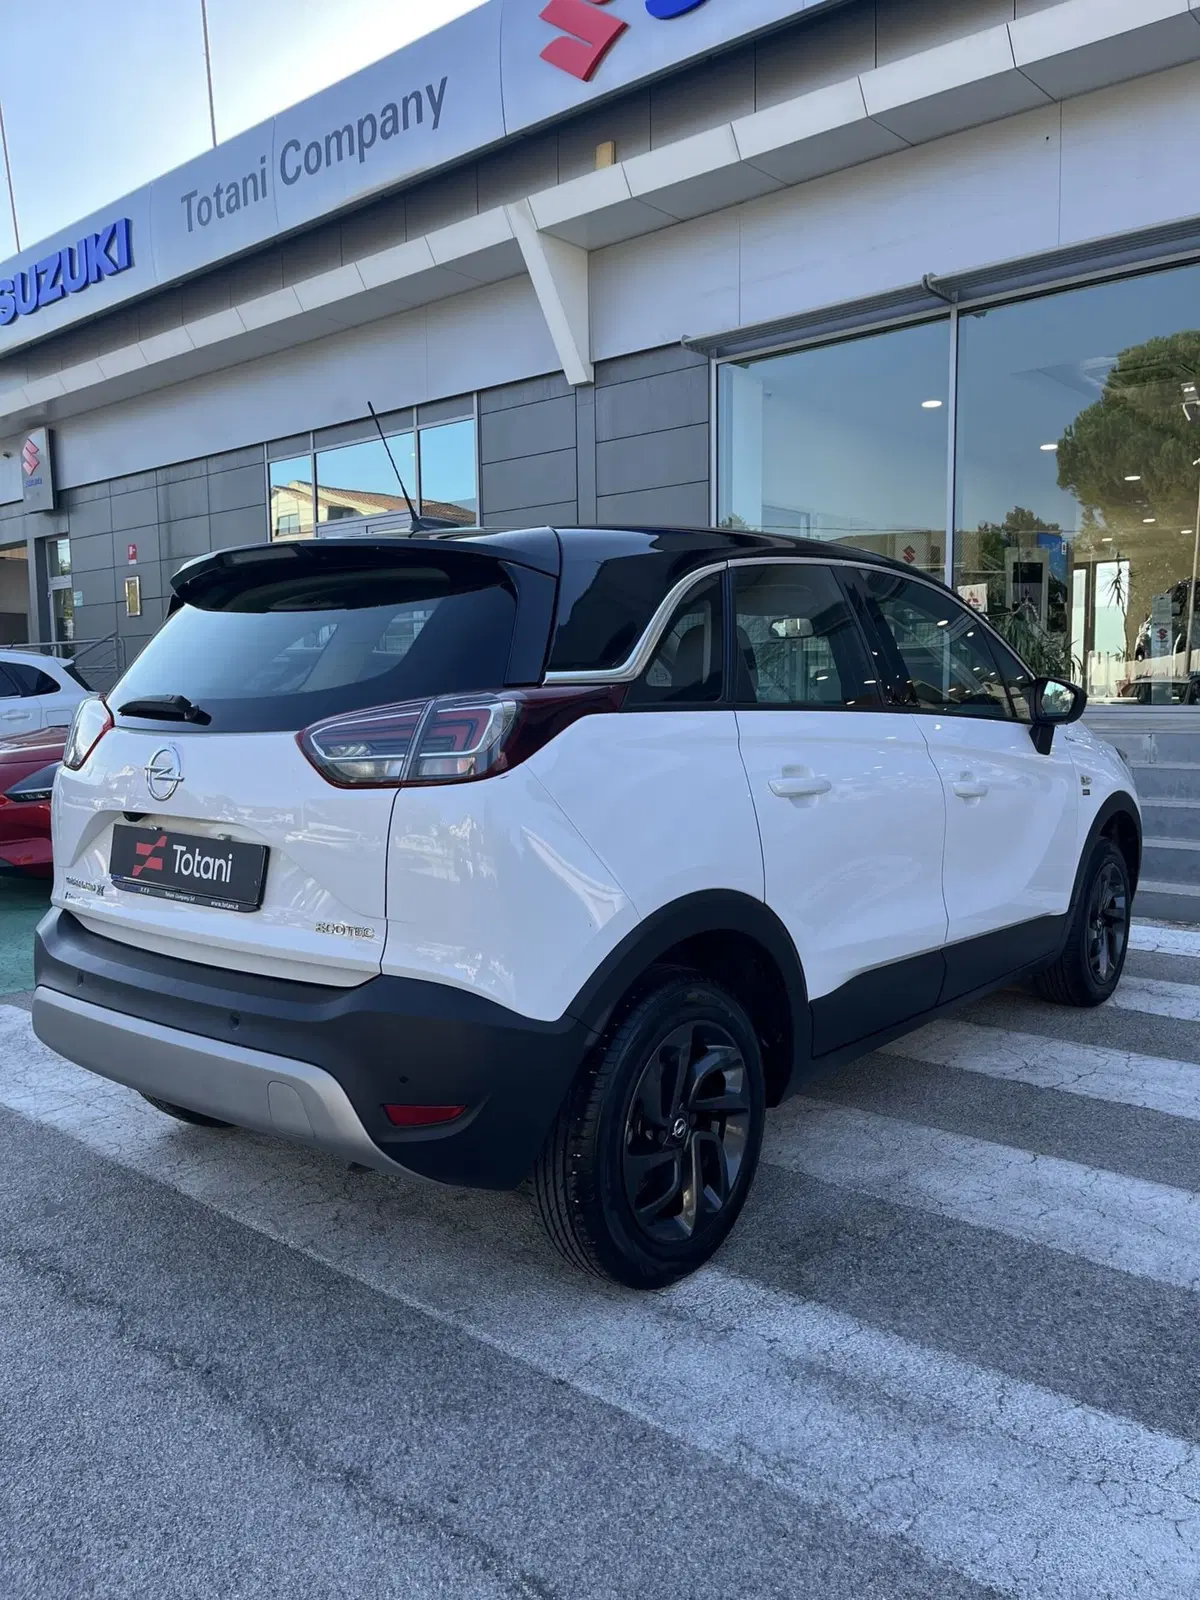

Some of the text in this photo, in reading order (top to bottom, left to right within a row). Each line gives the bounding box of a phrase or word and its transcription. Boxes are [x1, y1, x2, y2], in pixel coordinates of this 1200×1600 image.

[181, 76, 448, 233] Totani Company
[0, 217, 134, 326] SUZUKI
[173, 844, 233, 883] Totani
